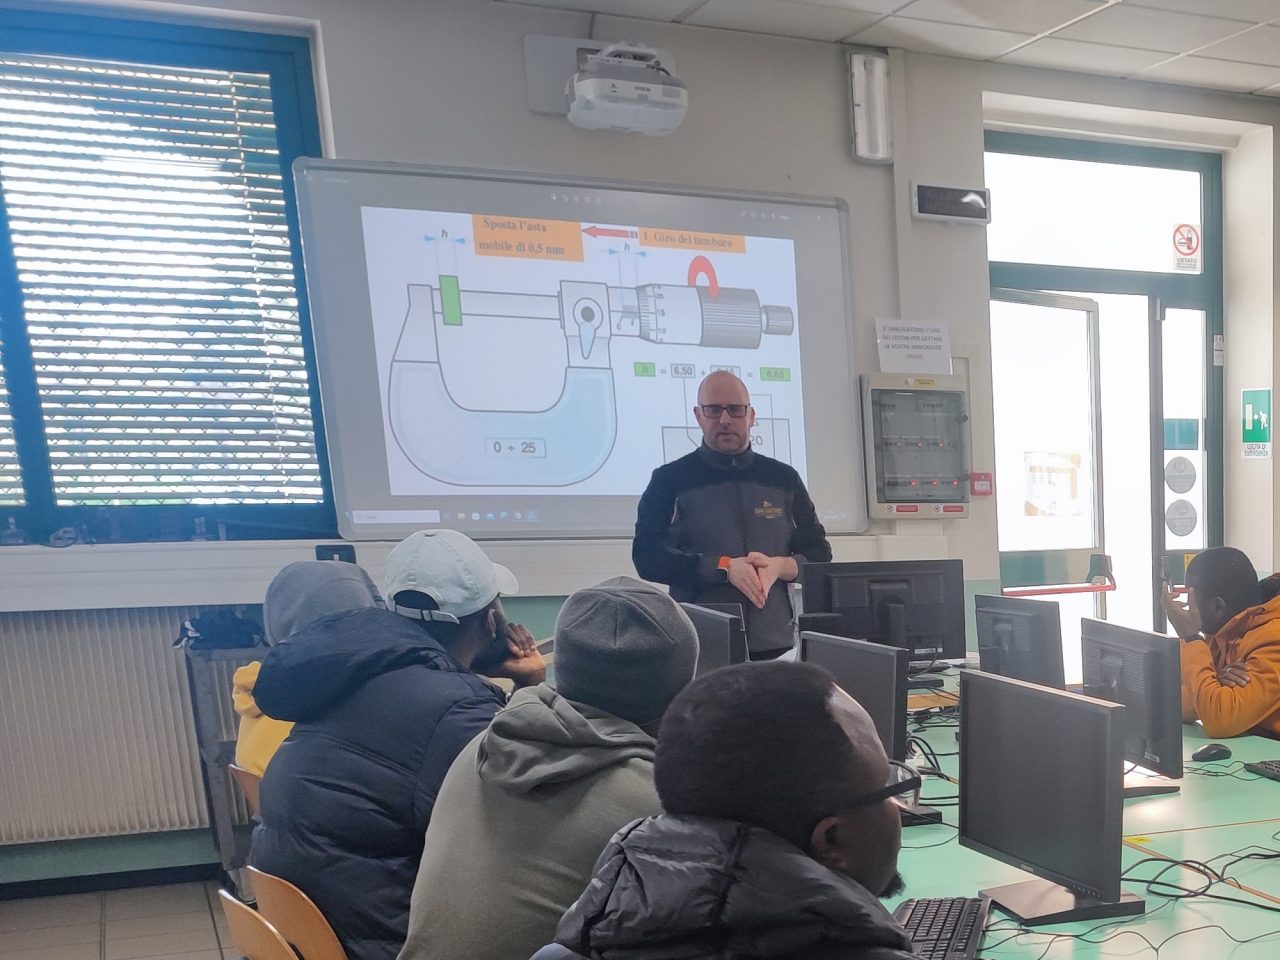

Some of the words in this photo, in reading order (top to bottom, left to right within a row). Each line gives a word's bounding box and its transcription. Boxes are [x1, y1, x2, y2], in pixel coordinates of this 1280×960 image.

[483, 218, 516, 231] Sposta
[441, 229, 448, 239] h
[654, 233, 675, 242] Giro
[678, 234, 690, 244] del
[694, 236, 733, 247] tamburo
[479, 241, 512, 251] mobile
[515, 242, 526, 253] di
[546, 246, 565, 255] mm
[520, 441, 536, 453] 25
